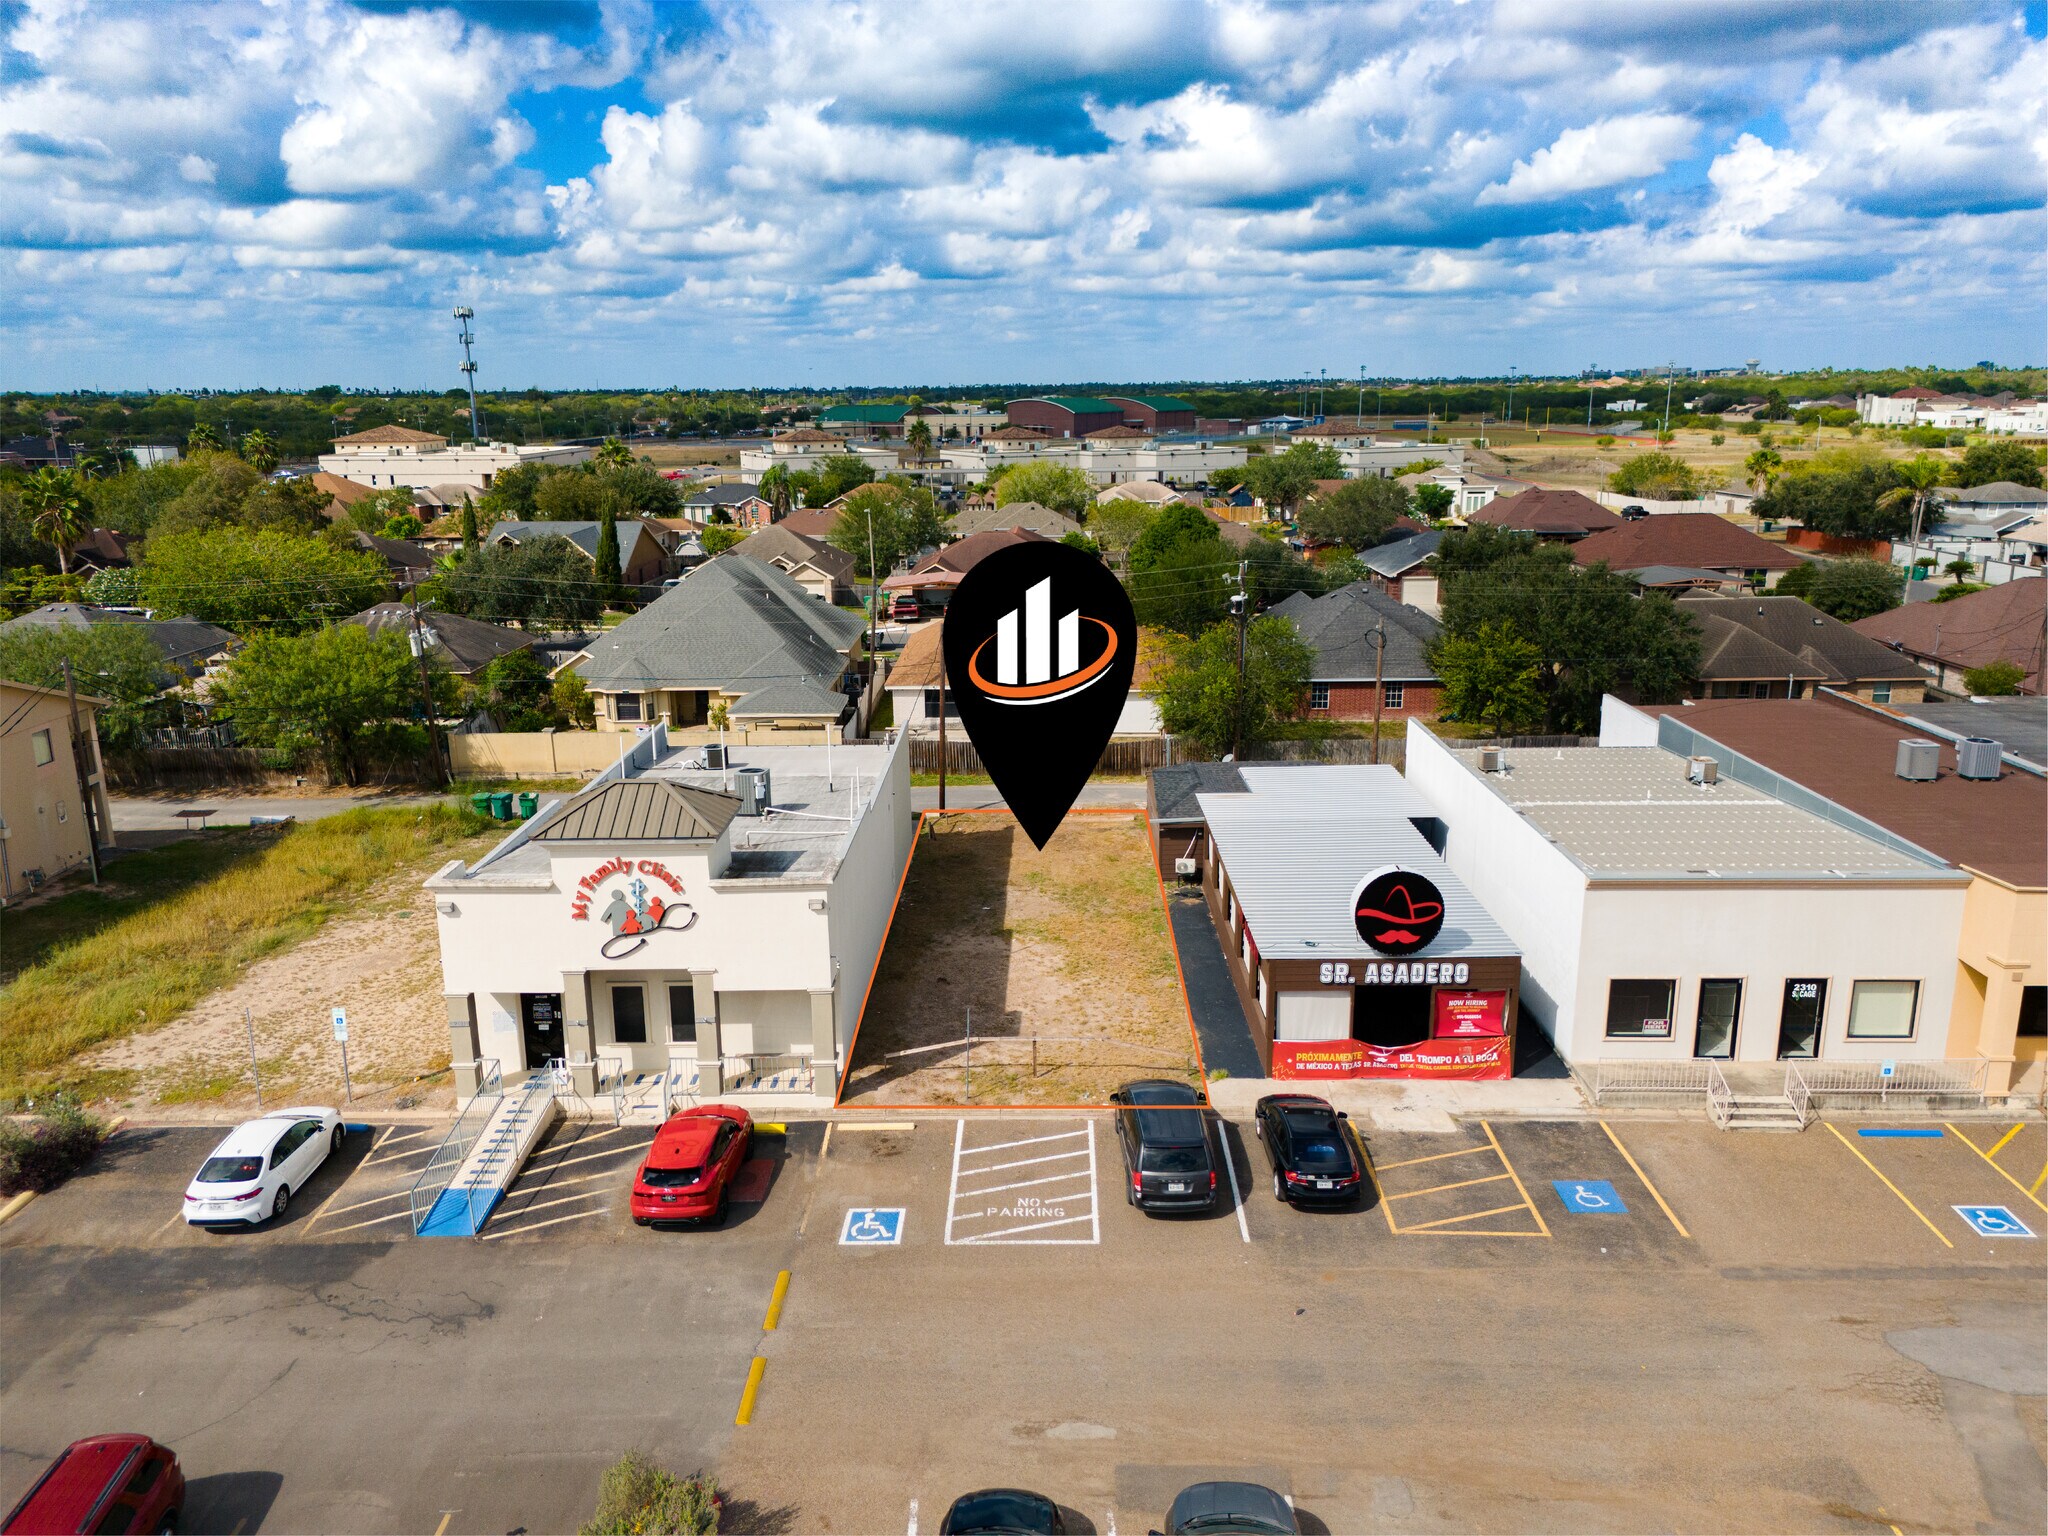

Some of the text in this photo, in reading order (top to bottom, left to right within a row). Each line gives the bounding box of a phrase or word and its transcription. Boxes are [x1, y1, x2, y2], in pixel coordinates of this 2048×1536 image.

[571, 856, 684, 919] My Family Clinic
[1319, 962, 1469, 984] SR. ASADERO
[1793, 983, 1817, 991] 2310
[1799, 990, 1817, 998] CAGE
[1296, 1052, 1363, 1062] PRÓXIMAMENTE
[1399, 1052, 1498, 1064] DEL TROMPO A TU BOCA
[1306, 1062, 1332, 1070] MÉXICO
[1341, 1062, 1362, 1071] TEXAS
[1017, 1197, 1040, 1207] NO
[987, 1207, 1065, 1217] PARKING
